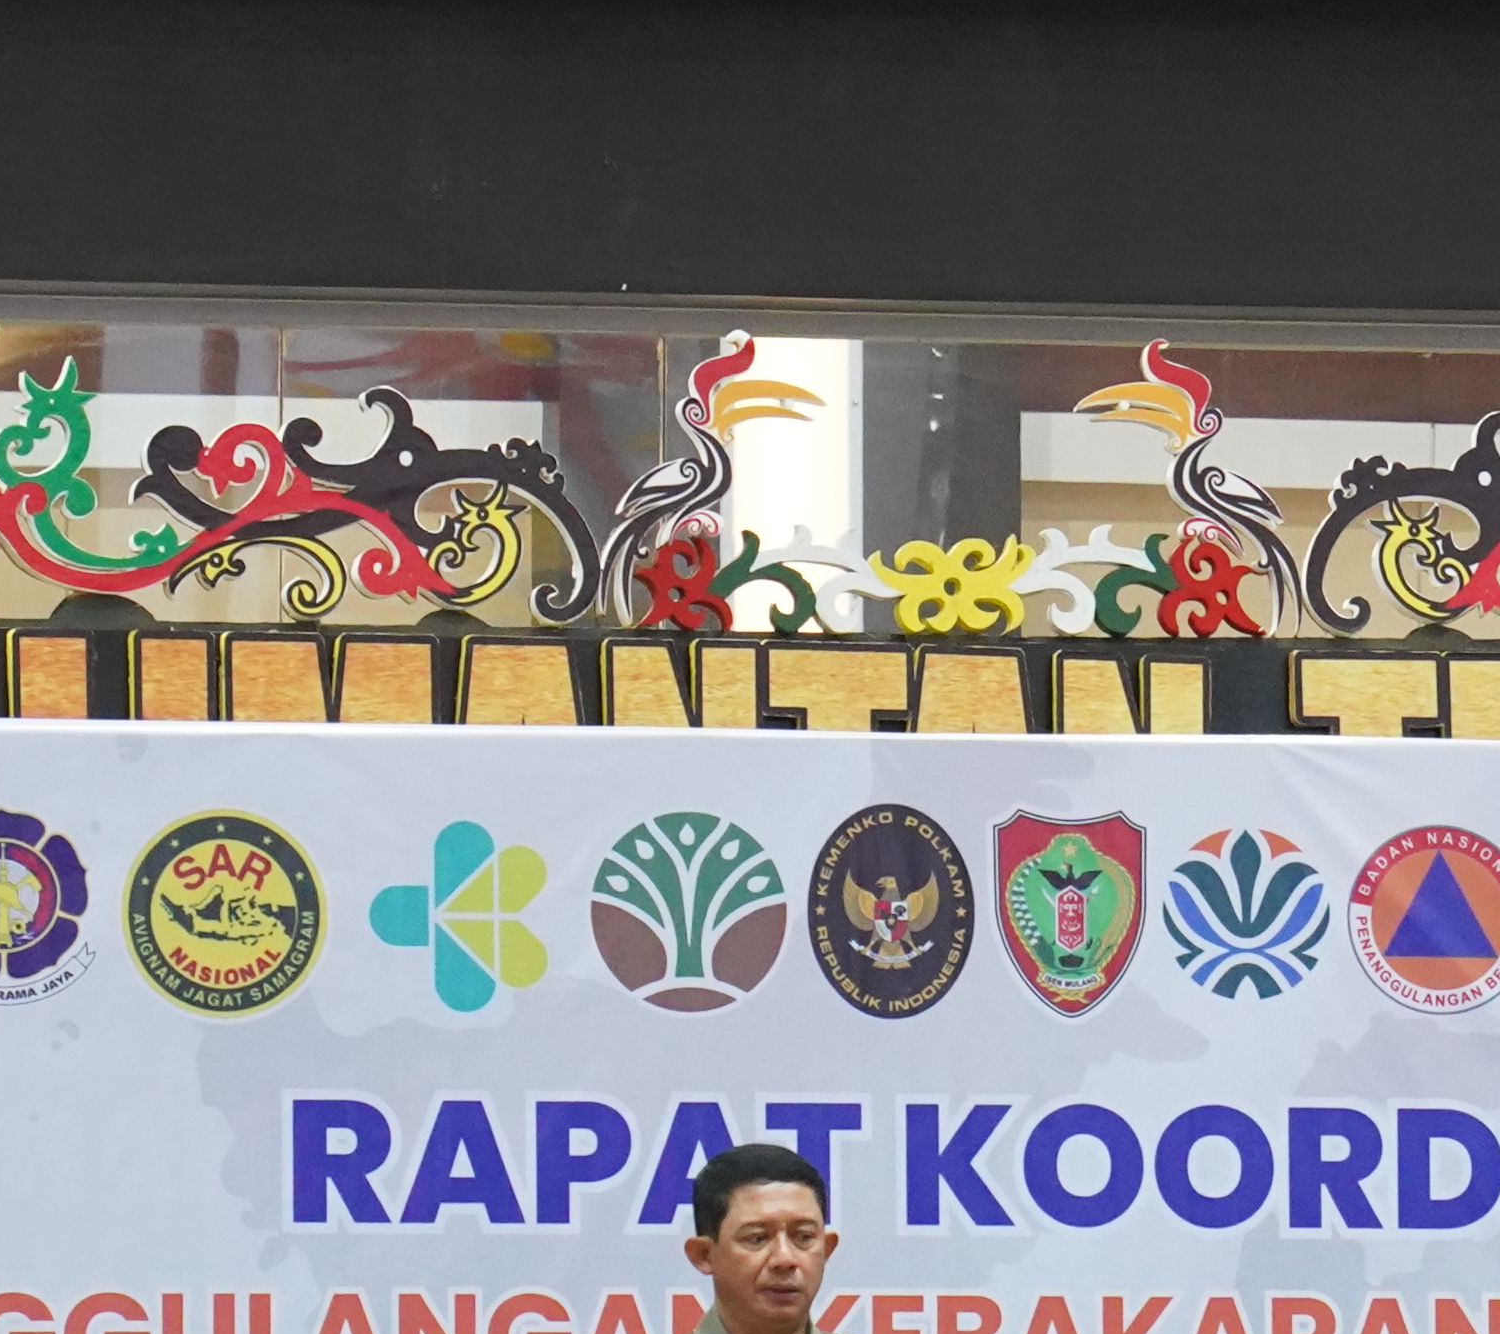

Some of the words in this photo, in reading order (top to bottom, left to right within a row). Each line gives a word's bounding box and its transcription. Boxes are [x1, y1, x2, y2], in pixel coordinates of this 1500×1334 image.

[173, 843, 272, 891] SAR
[816, 811, 893, 897] KEMENKO
[904, 816, 965, 897] POLKAM
[1358, 837, 1414, 896] BADAN
[41, 970, 74, 994] JAYA
[132, 913, 181, 991] AVIGNAM
[182, 986, 243, 1007] JAGAT
[250, 911, 315, 1002] SAMAGRAM
[168, 946, 282, 985] NASIONAL
[816, 925, 882, 1010] REPUBLIK
[889, 928, 966, 1012] INDONESIA
[1356, 915, 1483, 1007] PENANGGULANGAN
